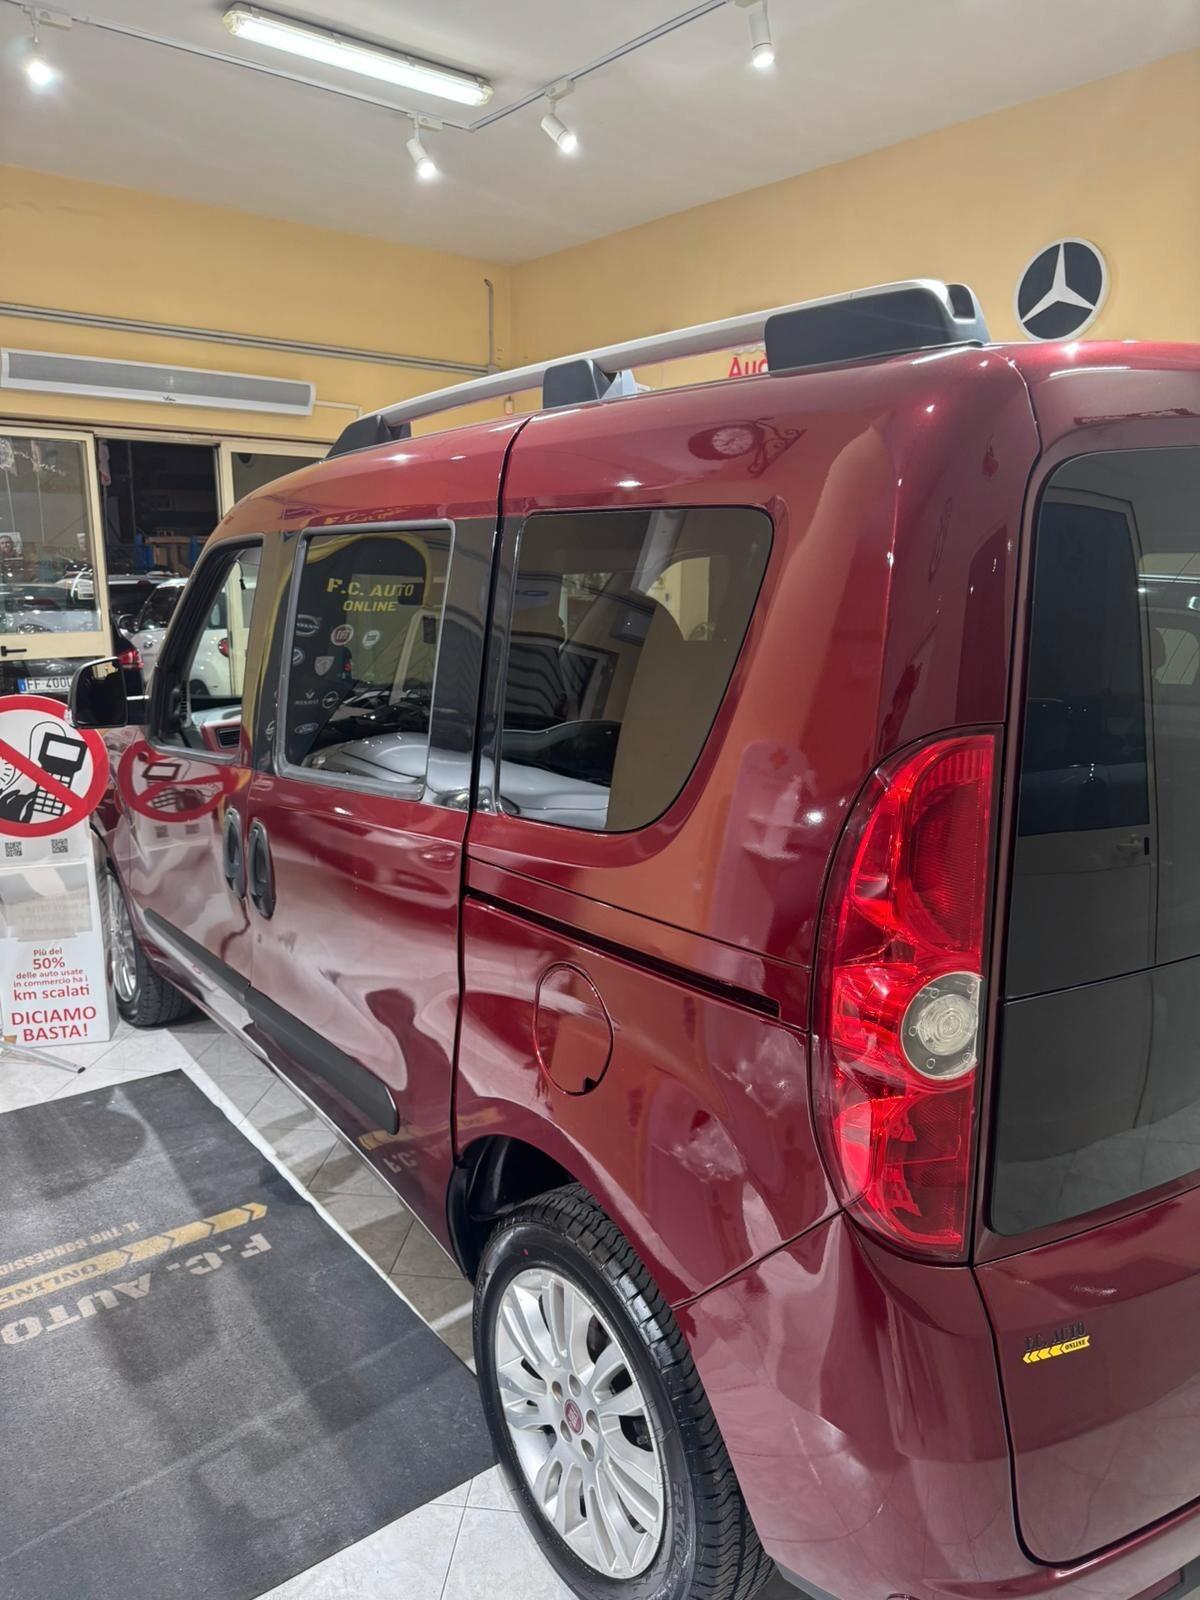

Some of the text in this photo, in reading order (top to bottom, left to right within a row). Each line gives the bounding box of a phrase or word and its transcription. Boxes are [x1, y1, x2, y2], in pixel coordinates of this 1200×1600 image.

[370, 583, 415, 598] AUTO
[343, 600, 397, 612] ONLINE
[27, 679, 40, 690] FF
[49, 947, 63, 955] del
[33, 957, 65, 970] 50%
[16, 969, 84, 980] delle auto usate
[24, 979, 71, 988] commercio
[72, 976, 83, 984] ha
[14, 984, 90, 1001] km scalati
[11, 1006, 97, 1026] DICIAMO
[23, 1023, 89, 1042] BASTA!
[1, 1272, 152, 1344] AUTO
[1064, 1339, 1086, 1350] ONLINE
